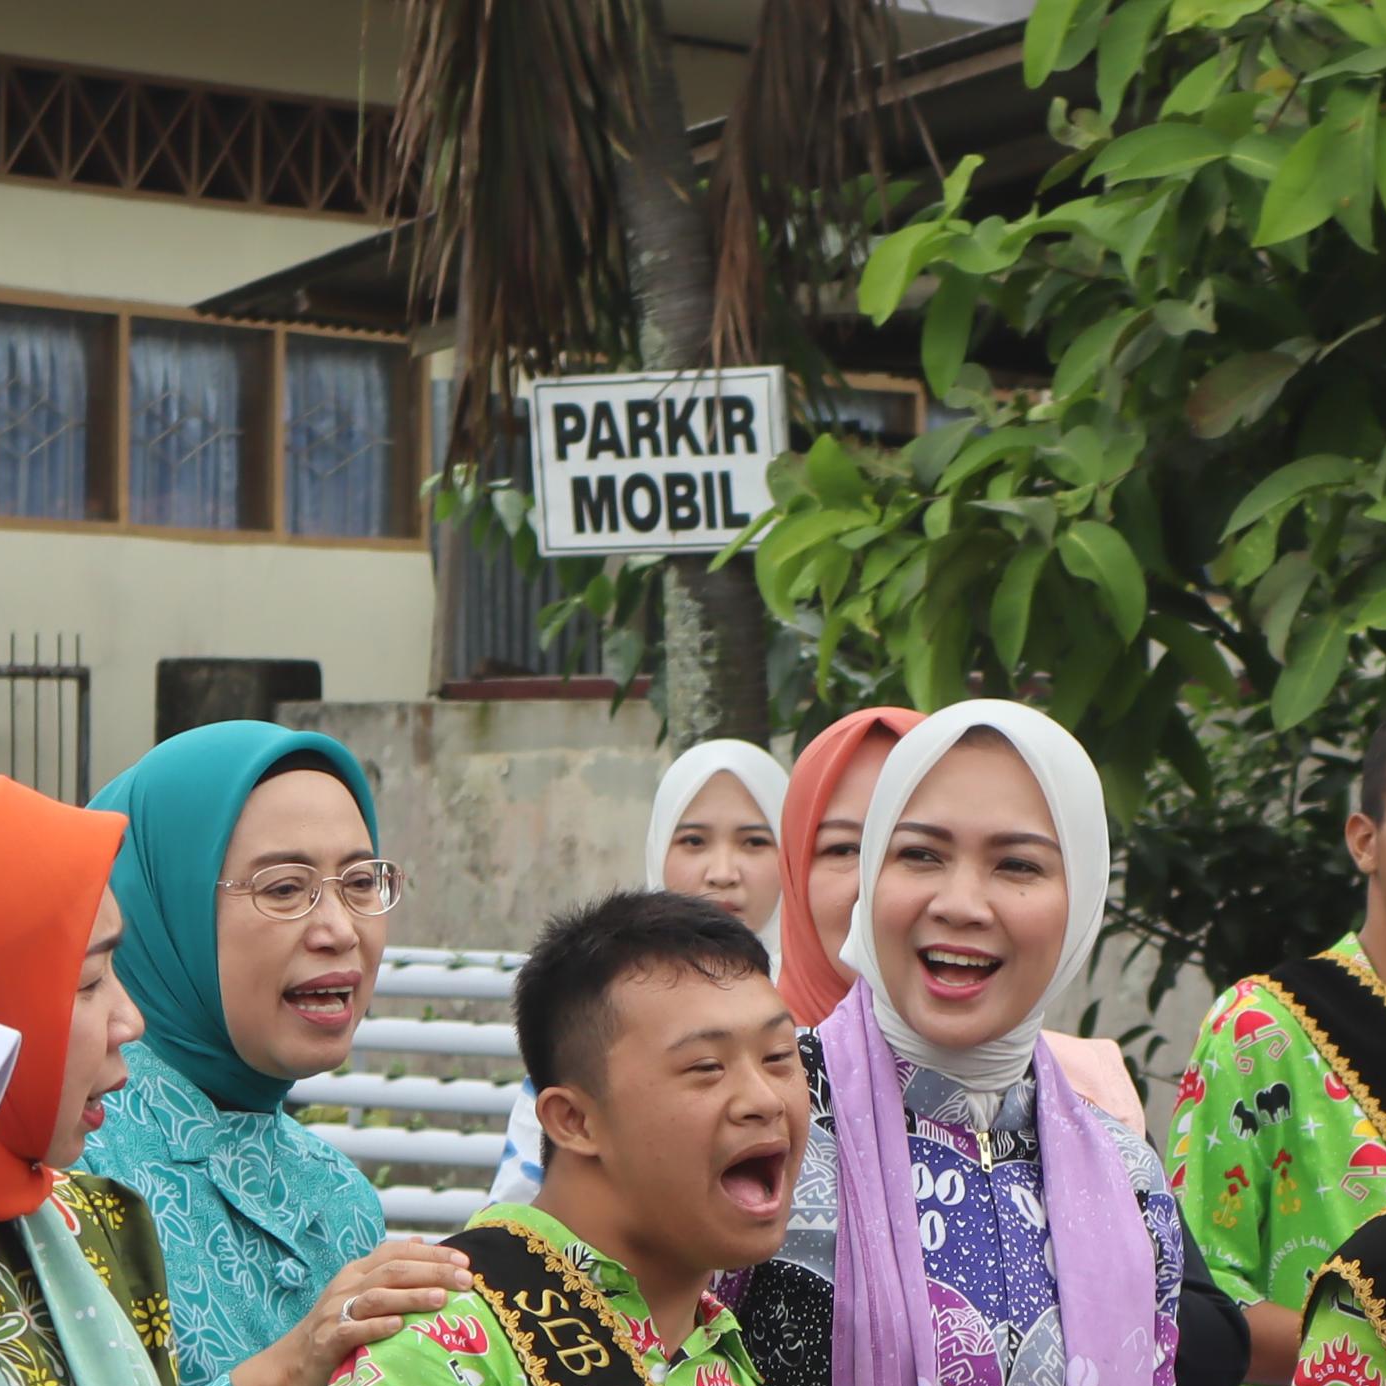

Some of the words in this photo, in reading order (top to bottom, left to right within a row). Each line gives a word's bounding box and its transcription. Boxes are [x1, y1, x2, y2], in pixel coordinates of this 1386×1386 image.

[553, 395, 758, 461] PARKIR
[571, 470, 750, 534] MOBIL
[513, 1288, 611, 1377] SLB
[1315, 1364, 1335, 1382] SLB
[1337, 1363, 1346, 1373] N
